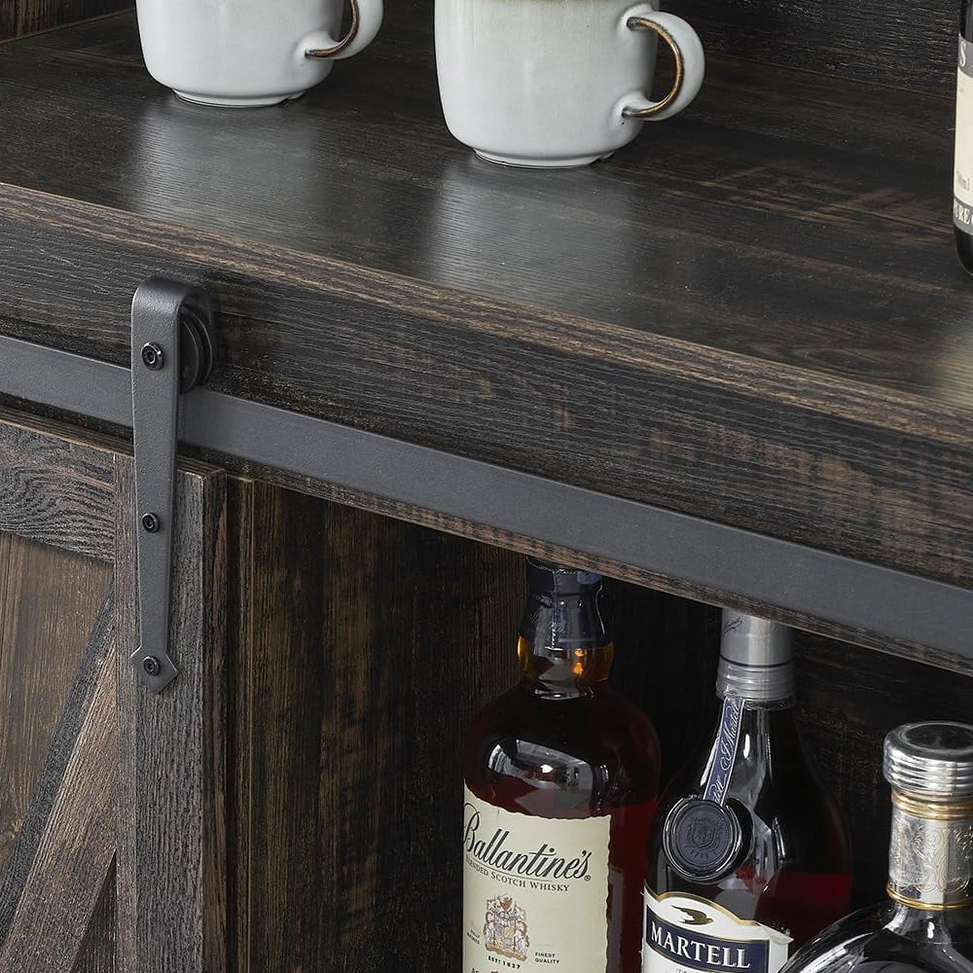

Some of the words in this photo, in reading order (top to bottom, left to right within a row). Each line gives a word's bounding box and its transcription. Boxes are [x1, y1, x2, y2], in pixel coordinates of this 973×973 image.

[464, 803, 593, 880] Ballantine's
[490, 872, 526, 888] SCOTCH
[530, 881, 570, 892] WHISKY
[651, 921, 750, 969] MARTELL
